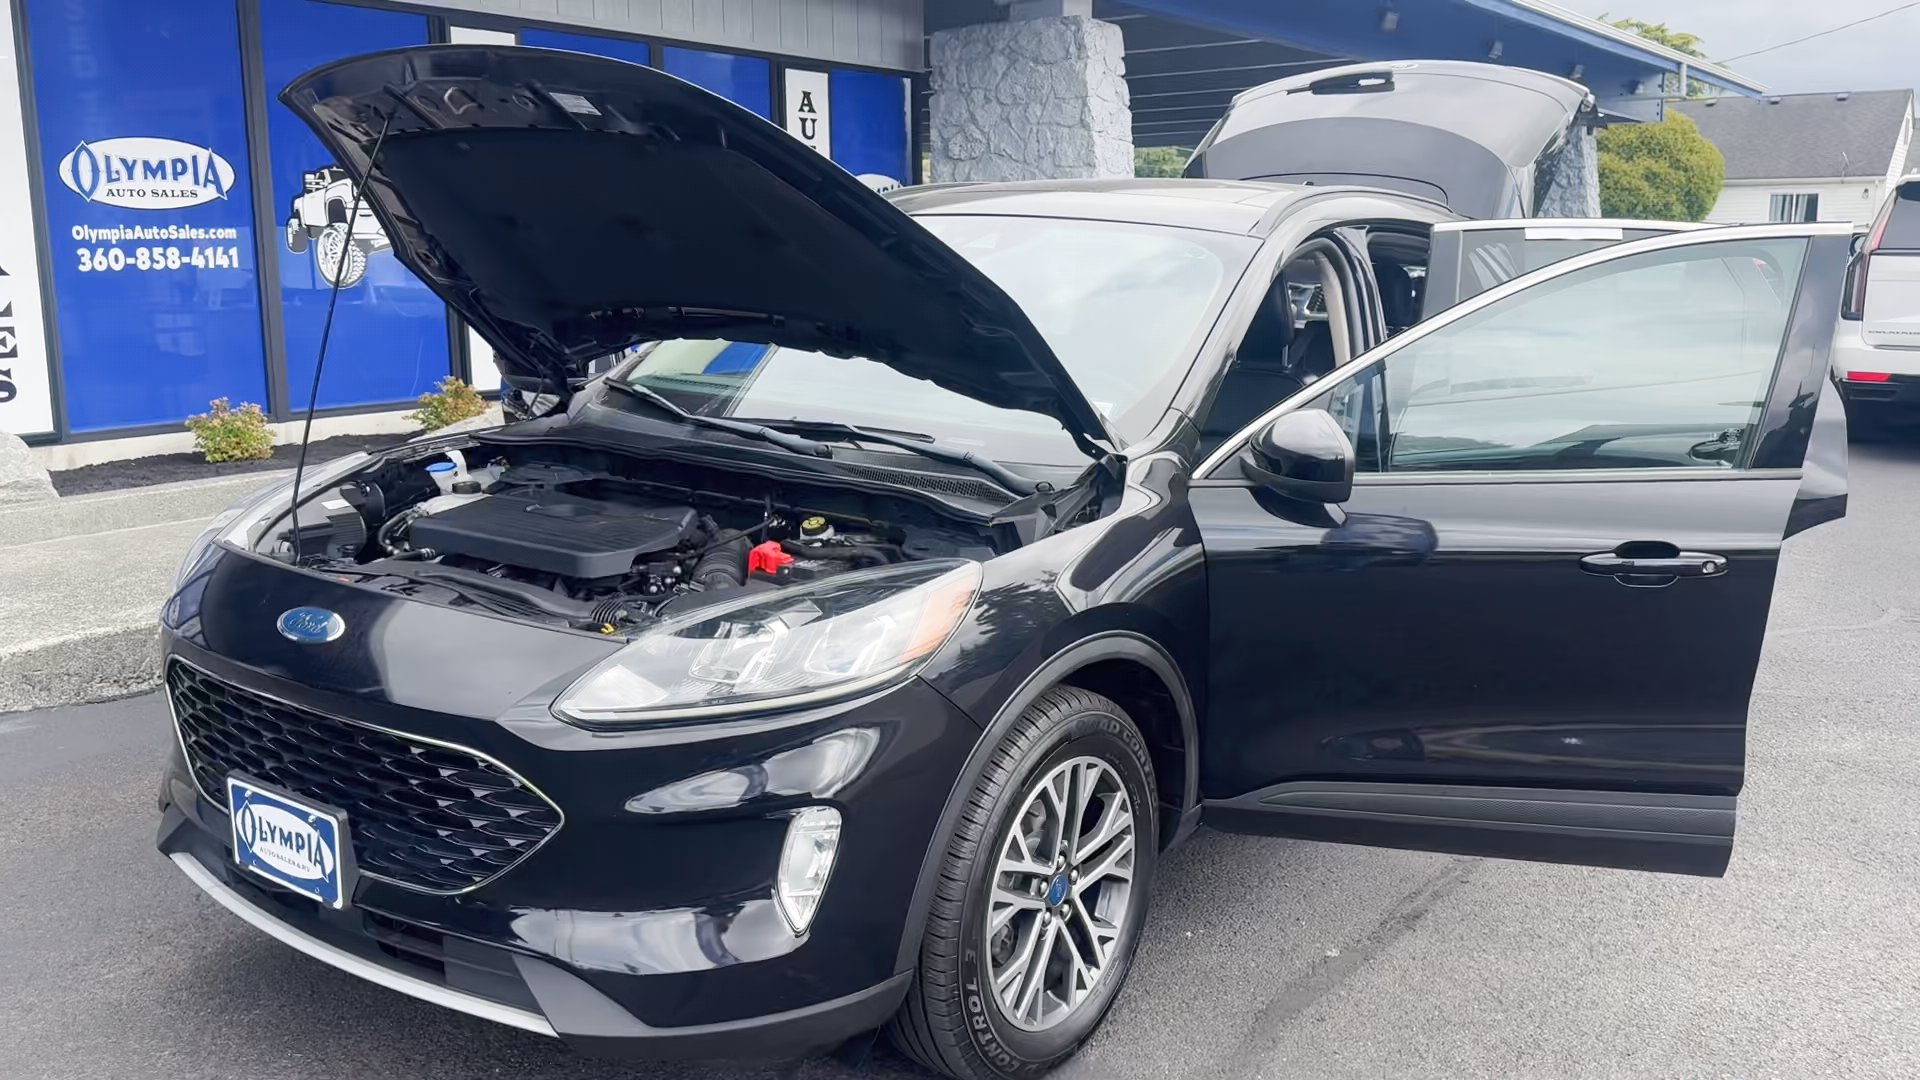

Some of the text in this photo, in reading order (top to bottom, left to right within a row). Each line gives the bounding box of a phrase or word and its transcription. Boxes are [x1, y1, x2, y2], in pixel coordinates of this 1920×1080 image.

[798, 91, 817, 150] AU
[70, 140, 227, 202] OLYMPIA
[105, 188, 199, 198] AUTO SALES
[71, 224, 237, 244] OlympiaAutoSales.com
[76, 246, 239, 272] 360-858-4141
[241, 799, 329, 883] OLYMPIA
